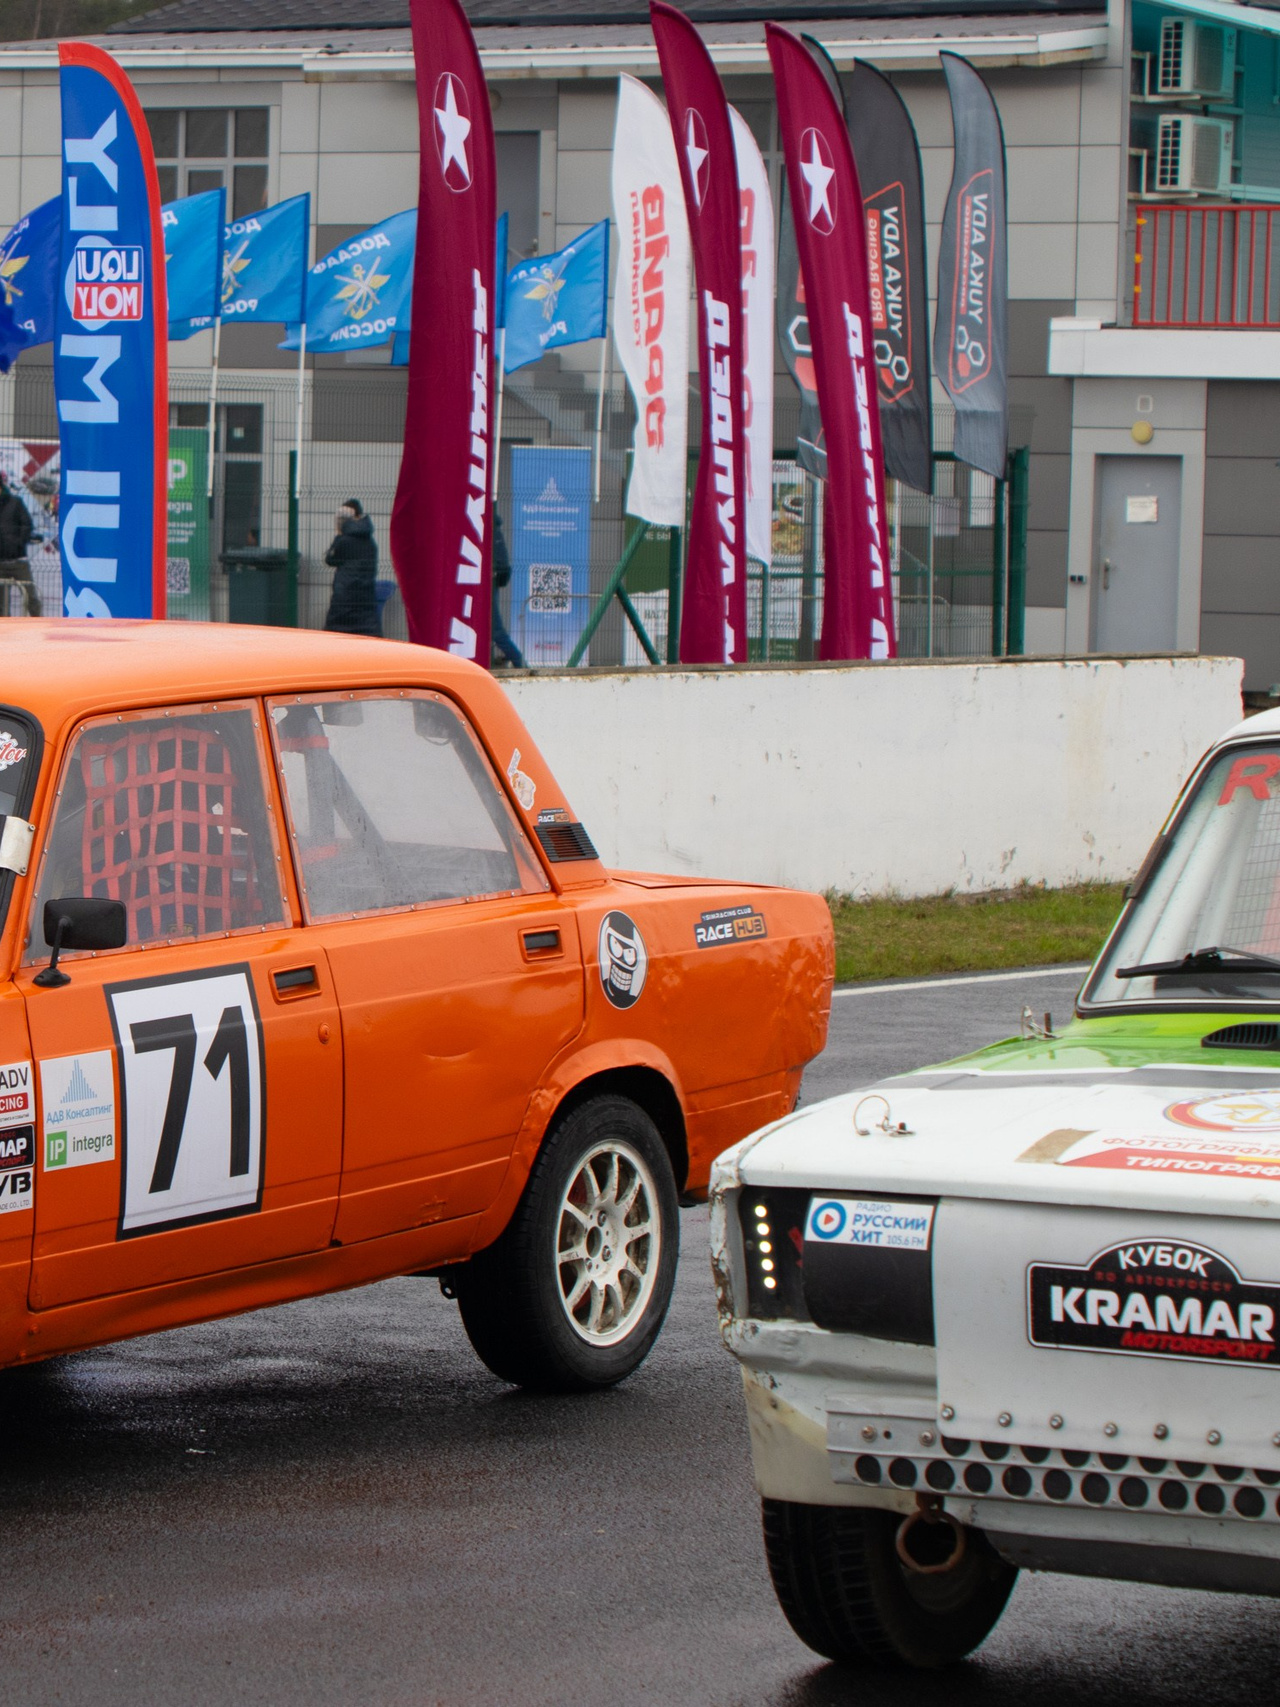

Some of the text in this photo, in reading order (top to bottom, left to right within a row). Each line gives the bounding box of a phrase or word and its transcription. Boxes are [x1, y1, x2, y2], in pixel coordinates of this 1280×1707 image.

[696, 919, 763, 943] RACE HUB
[129, 1005, 251, 1194] 71
[46, 1104, 113, 1125] АДВ Консалтинг
[50, 1138, 65, 1162] IP
[72, 1134, 113, 1153] integra
[856, 1202, 892, 1213] РАДИО
[852, 1213, 927, 1231] РУССКИЙ
[850, 1229, 925, 1246] ХИТ 105.6 FM
[1118, 1245, 1213, 1278] КУБОК
[1050, 1285, 1276, 1342] KRAMAR
[1121, 1331, 1276, 1360] MOTORSPORT
